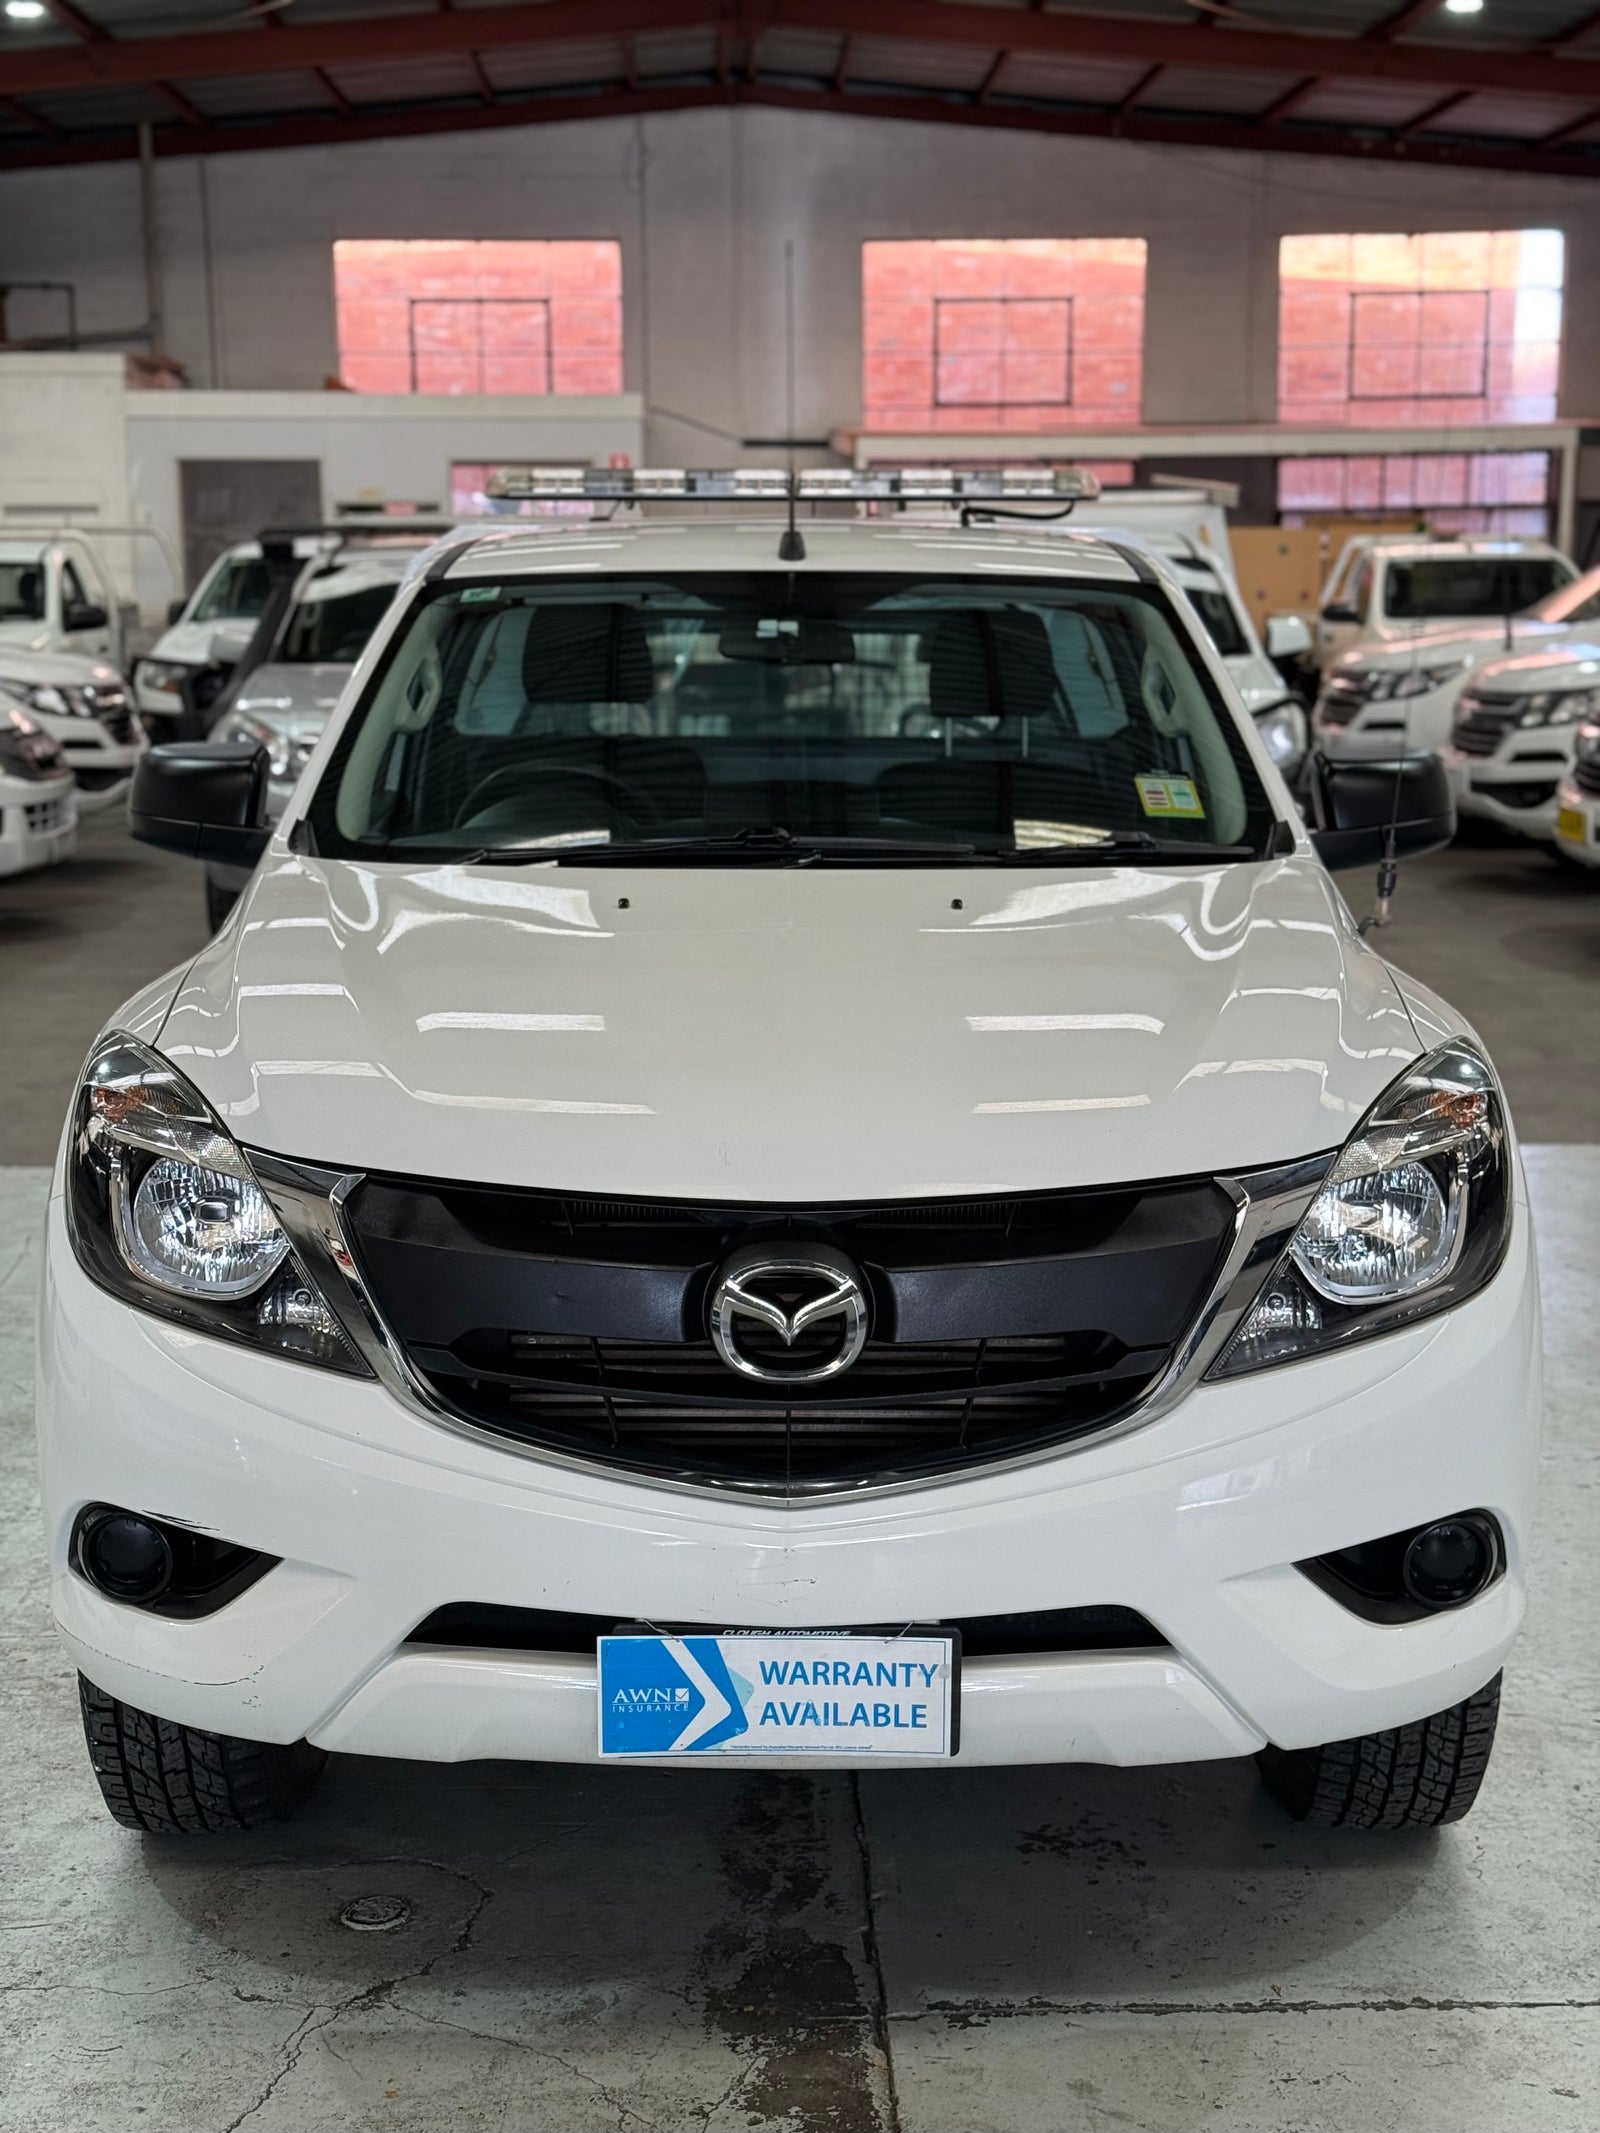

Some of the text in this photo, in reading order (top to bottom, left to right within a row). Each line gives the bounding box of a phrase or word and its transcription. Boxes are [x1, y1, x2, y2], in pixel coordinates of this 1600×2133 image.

[759, 1661, 939, 1688] WARRANTY
[612, 1688, 672, 1703] AWN
[612, 1703, 688, 1713] INSURANCE
[759, 1701, 927, 1728] AVAILABLE
